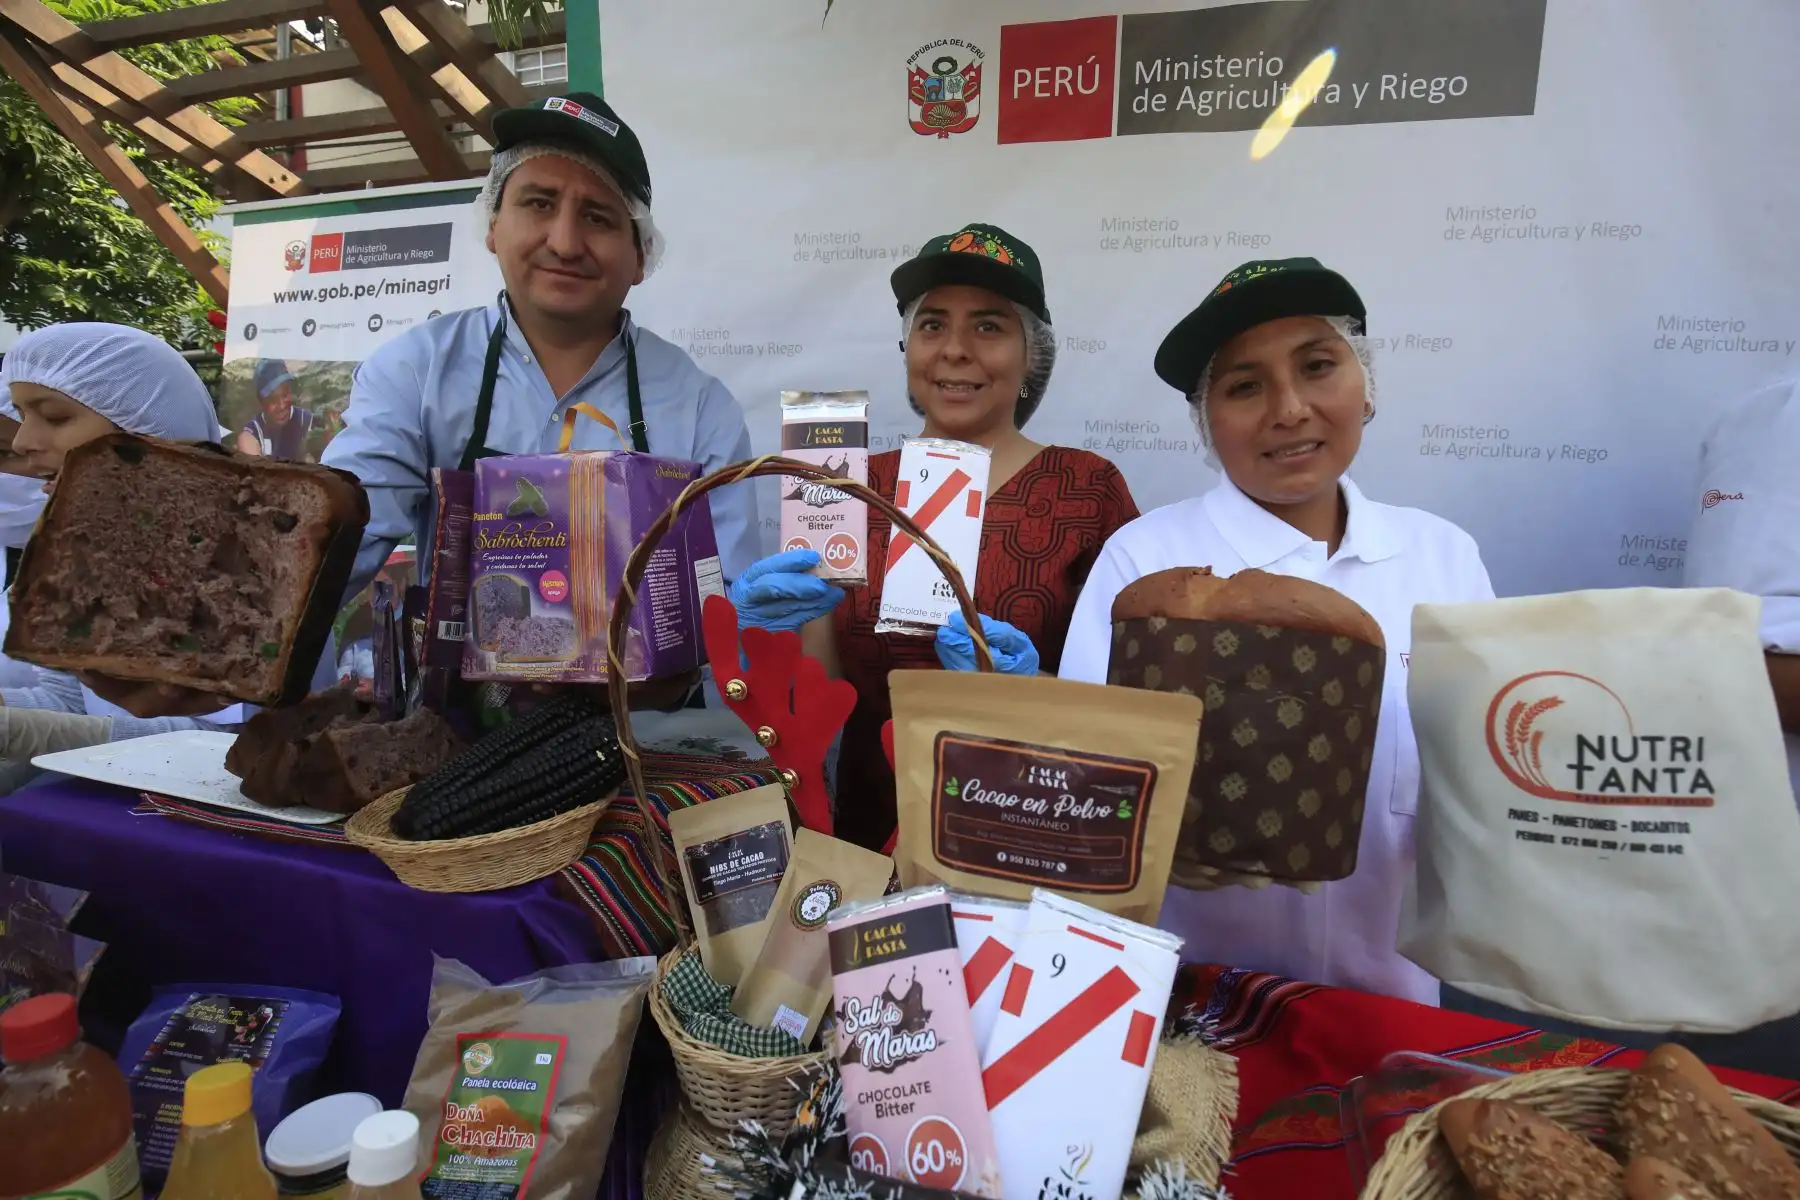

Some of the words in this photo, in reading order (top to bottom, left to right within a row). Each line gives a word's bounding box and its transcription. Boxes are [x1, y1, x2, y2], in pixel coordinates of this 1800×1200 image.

[907, 39, 948, 66] REPÚBLICA
[950, 39, 965, 48] DEL
[966, 42, 985, 60] PERÚ
[1013, 55, 1100, 99] PERÚ
[1135, 51, 1284, 85] Ministerio
[1132, 87, 1167, 114] de
[1352, 80, 1369, 109] y
[1379, 73, 1468, 104] Riego
[1445, 204, 1537, 222] Ministerio
[1100, 216, 1179, 232] Ministerio
[1443, 224, 1465, 241] de
[1470, 222, 1569, 243] Agricultura
[1574, 225, 1586, 241] y
[1590, 221, 1643, 241] Riego
[793, 230, 860, 246] Ministerio
[1100, 235, 1119, 250] de
[1123, 233, 1209, 252] Agricultura
[1213, 235, 1222, 249] y
[1226, 231, 1272, 249] Riego
[313, 245, 340, 260] PERÚ
[346, 243, 388, 254] Ministerio
[346, 254, 355, 264] de
[356, 251, 402, 264] Agricultura
[403, 252, 409, 262] y
[410, 249, 434, 262] Riego
[793, 249, 810, 262] de
[812, 244, 887, 264] Agricultura
[891, 247, 899, 262] y
[273, 275, 451, 304] www.gob.pe/minagri
[1656, 314, 1746, 334] Ministerio
[671, 329, 730, 342] Ministerio
[1066, 336, 1107, 353] Riego
[1390, 336, 1400, 353] y
[1405, 334, 1453, 352] Riego
[1653, 334, 1676, 351] de
[1680, 333, 1779, 354] Agricultura
[1783, 338, 1796, 356] y
[689, 341, 753, 358] Agricultura
[768, 342, 803, 358] Riego
[815, 426, 845, 436] CACAO
[1084, 419, 1160, 434] Ministerio
[1422, 423, 1510, 441] Ministerio
[815, 436, 844, 445] PASTA
[1083, 436, 1102, 450] de
[1105, 436, 1187, 453] Agricultura
[1191, 440, 1201, 454] y
[1419, 441, 1442, 457] de
[1445, 442, 1541, 460] Agricultura
[1546, 445, 1556, 461] y
[1561, 444, 1608, 464] Riego
[920, 468, 929, 483] 9
[473, 510, 503, 522] Panetón
[797, 513, 845, 522] CHOCOLATE
[808, 522, 834, 531] Bitter
[1620, 533, 1688, 551] Ministe
[827, 543, 857, 560] 60%
[1618, 551, 1640, 567] de
[883, 603, 928, 619] Chocolate
[929, 607, 942, 619] de
[1577, 733, 1704, 763] NUTRI
[962, 778, 1018, 808] Cacao
[1023, 799, 1049, 815] en
[1053, 795, 1113, 820] Polvo
[710, 862, 728, 875] NIBS
[730, 859, 740, 869] DE
[741, 851, 765, 865] CACAO
[811, 886, 827, 895] Polvo
[864, 923, 905, 944] CACAO
[865, 938, 908, 959] PASTA
[1051, 953, 1066, 978] 9
[845, 996, 882, 1033] Sal
[883, 1007, 902, 1025] de
[859, 1028, 938, 1068] Maras
[461, 1077, 490, 1088] Panela
[492, 1078, 537, 1091] ecológica
[858, 1081, 932, 1105] CHOCOLATE
[875, 1100, 916, 1119] Bitter
[448, 1155, 471, 1165] 100%
[474, 1156, 518, 1167] Amazonas
[912, 1139, 962, 1175] 60%
